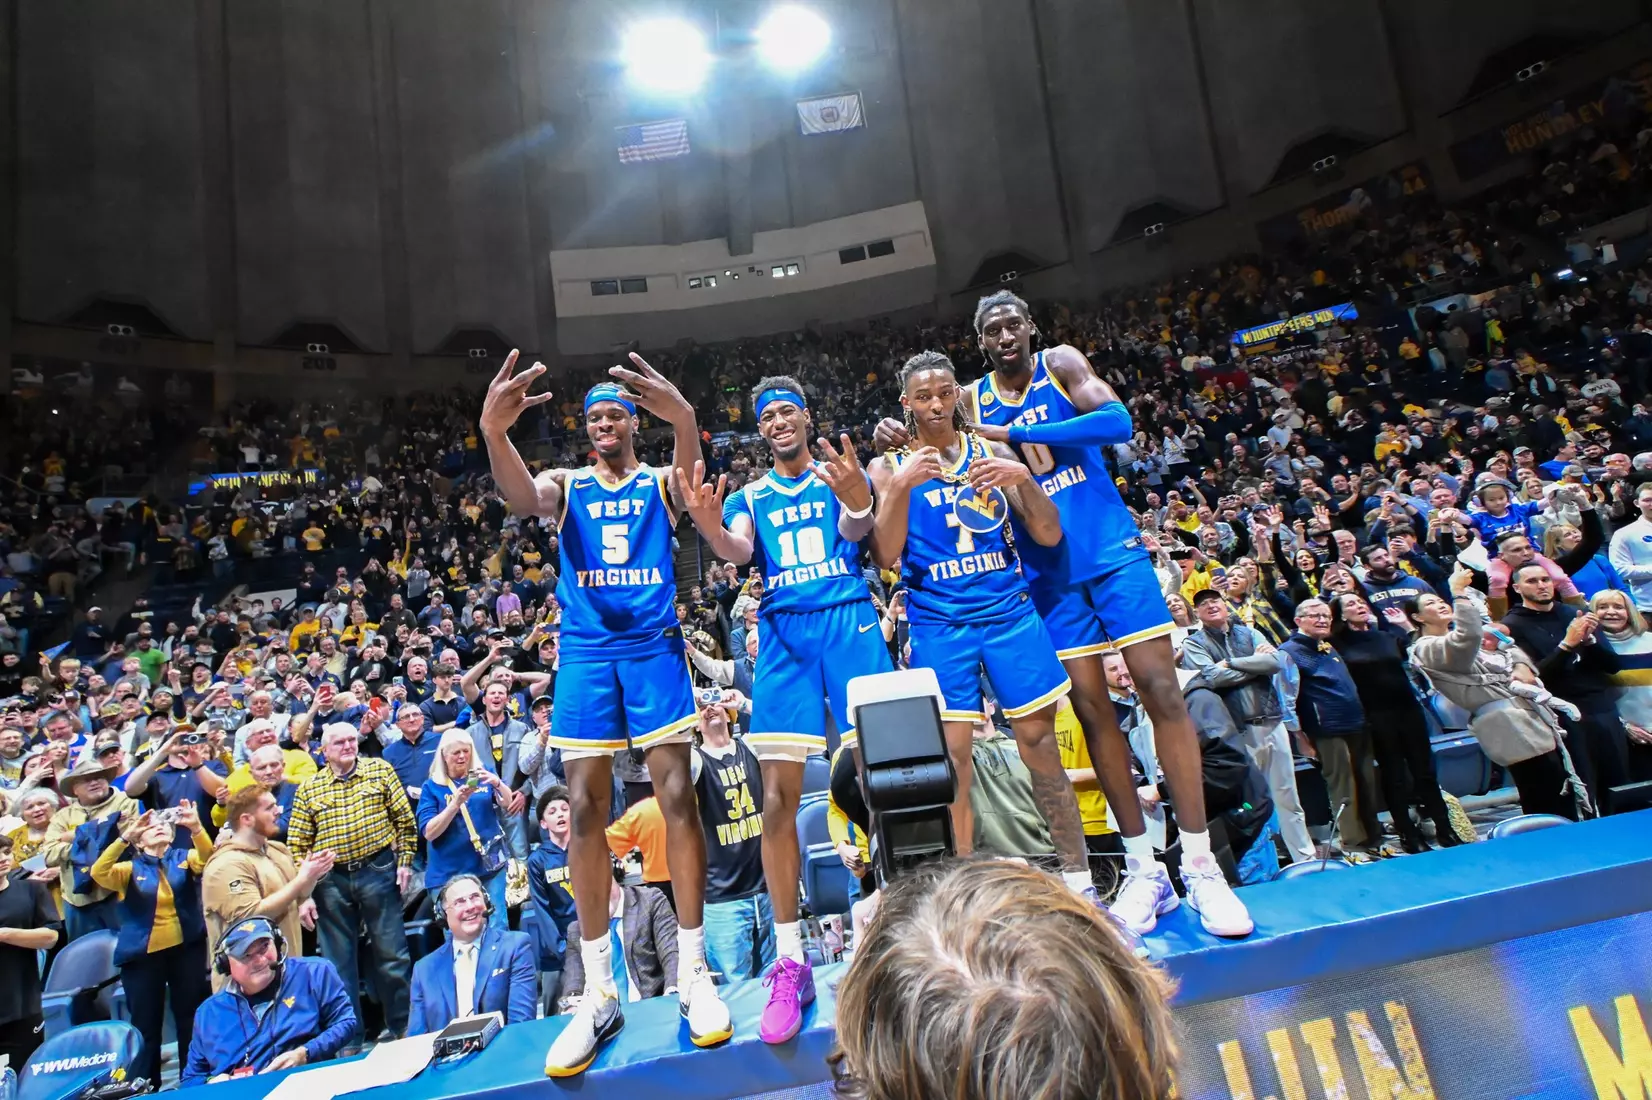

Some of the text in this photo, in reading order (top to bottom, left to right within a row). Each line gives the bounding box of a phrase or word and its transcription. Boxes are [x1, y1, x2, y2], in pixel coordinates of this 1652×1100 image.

[1008, 404, 1048, 427] EST
[924, 485, 958, 507] WE
[1041, 465, 1087, 497] GINIA
[586, 498, 645, 520] WEST
[767, 501, 826, 528] WEST
[602, 524, 629, 565] 5
[778, 526, 826, 567] 10
[576, 567, 663, 588] VIRGINIA
[768, 557, 849, 590] VIRGINIA
[928, 551, 1007, 582] VIRGINIA
[725, 783, 756, 820] 34
